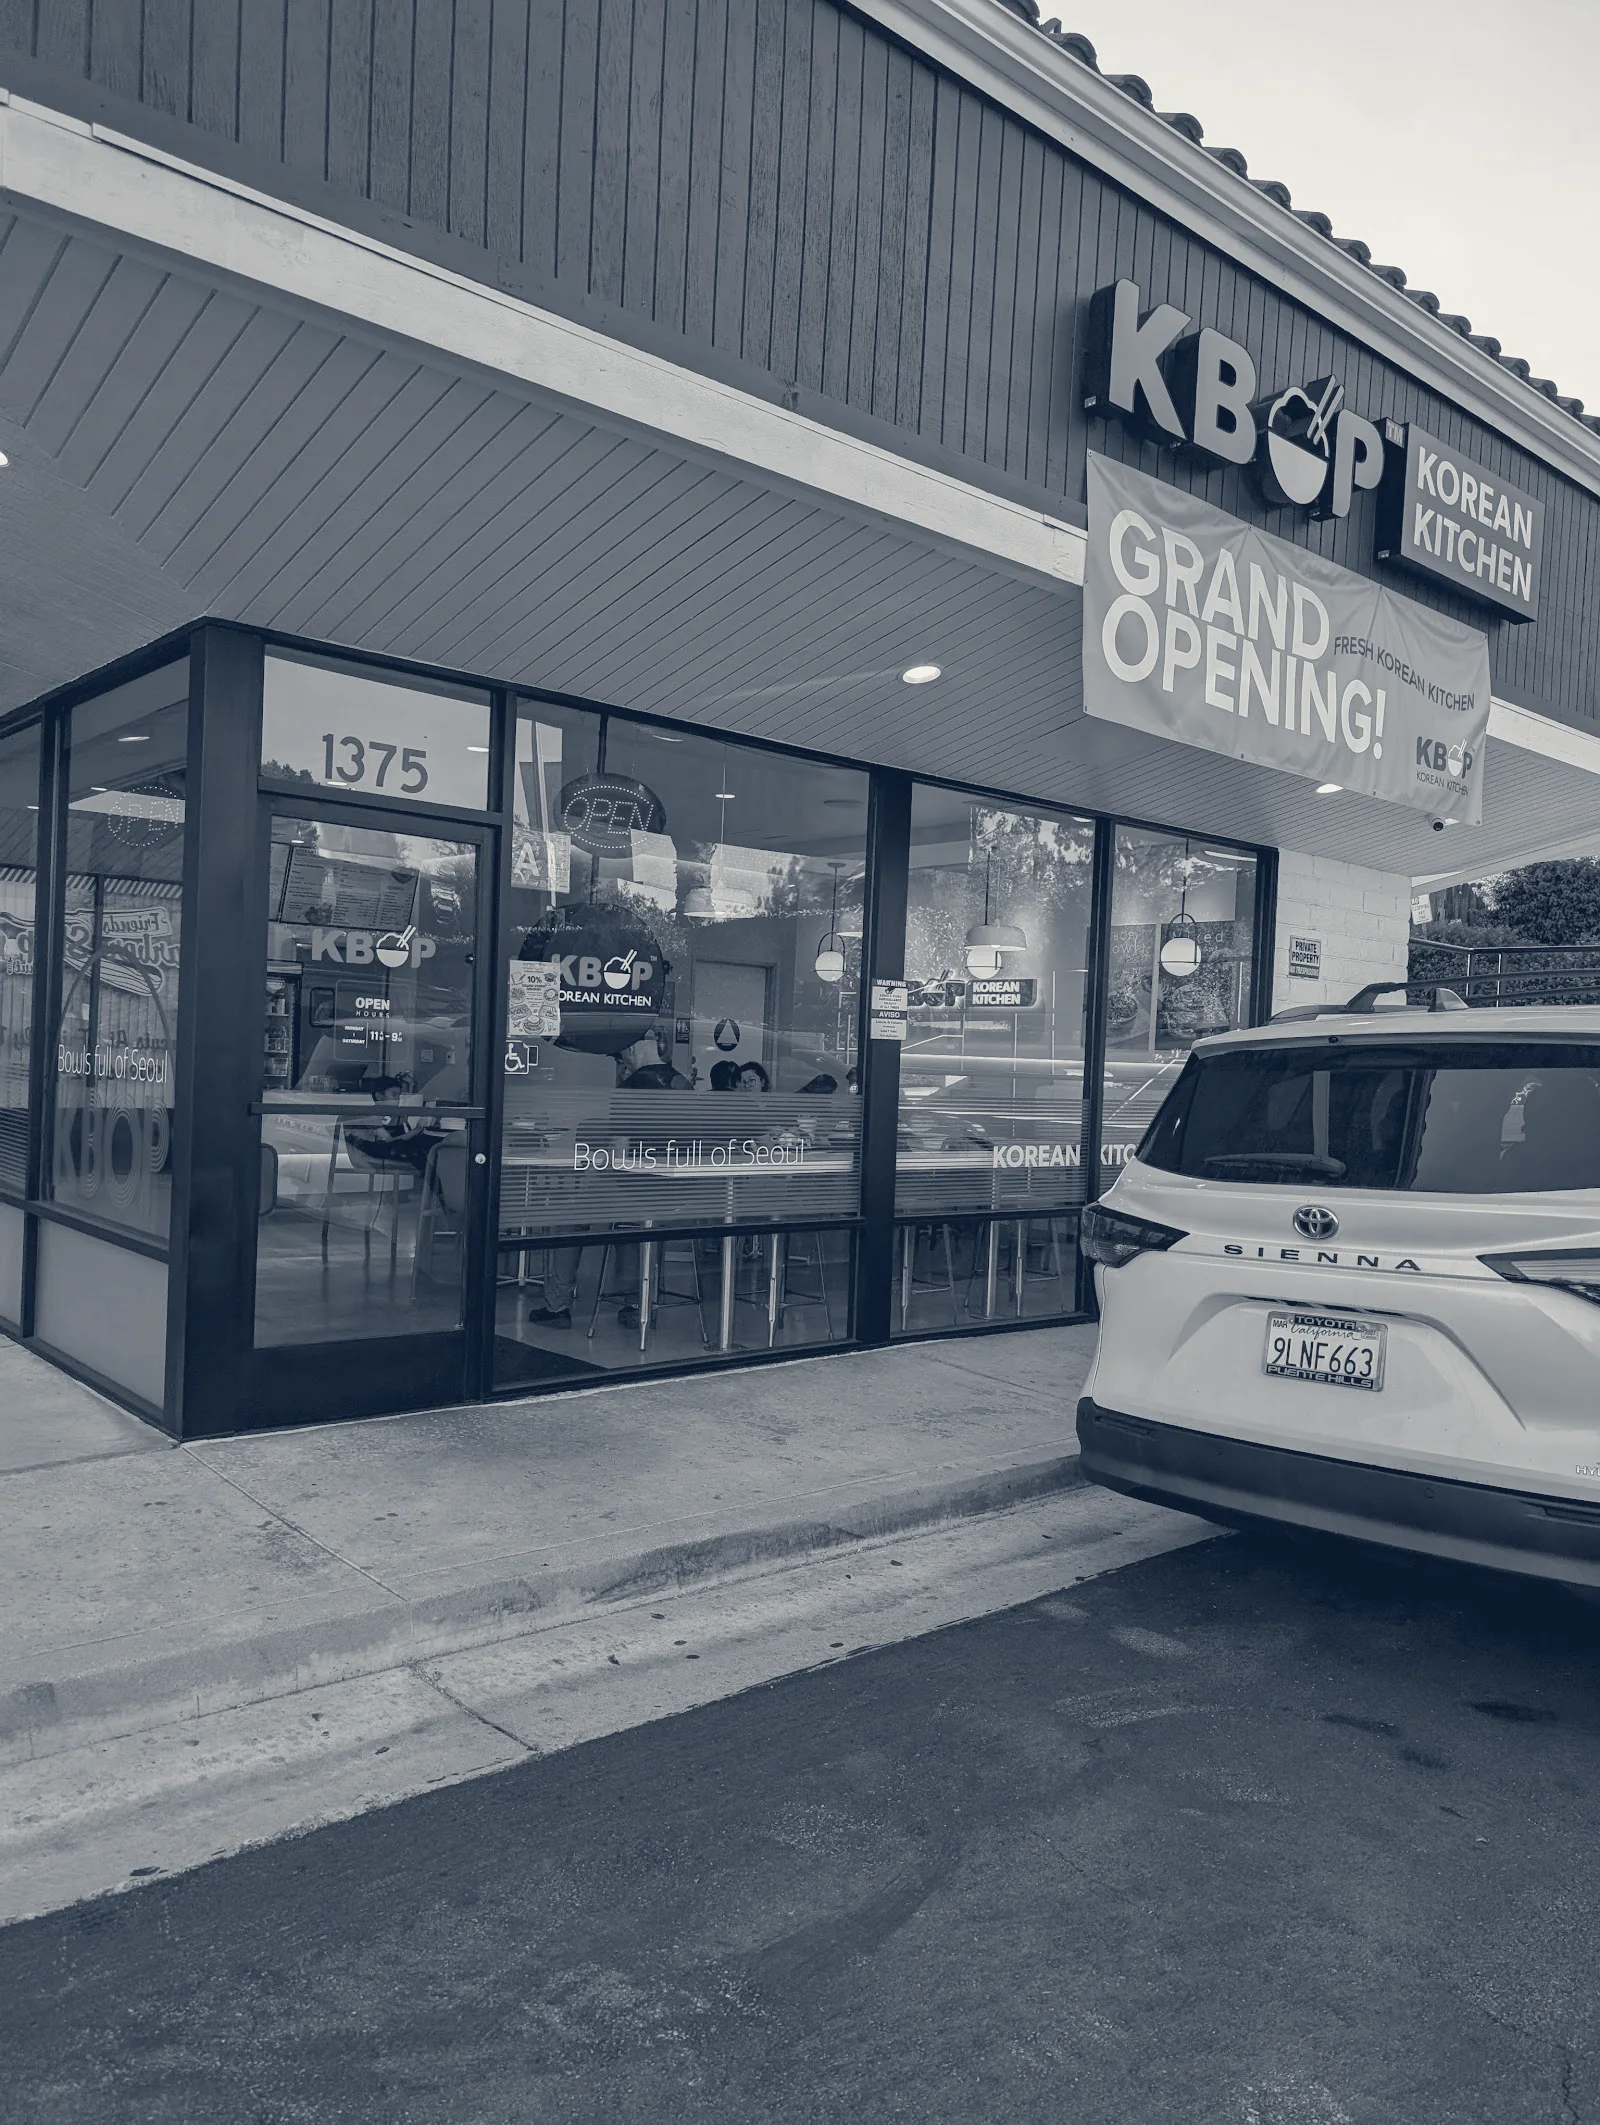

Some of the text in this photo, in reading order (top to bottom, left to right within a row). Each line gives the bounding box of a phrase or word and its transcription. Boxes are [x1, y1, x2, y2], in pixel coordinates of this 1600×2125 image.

[1417, 447, 1533, 550] KOREAN
[1414, 503, 1532, 602] KITCHEN
[1109, 509, 1330, 660] GRAND
[1102, 594, 1386, 760] OPENING!
[1334, 636, 1475, 711] FRESH KOREAN KITCHEN
[322, 733, 429, 793] 1375
[1416, 770, 1469, 796] KOREAN KITCHEN
[107, 801, 180, 833] OPEN
[564, 797, 654, 836] OPEN
[1292, 951, 1320, 964] PROPERTY
[1295, 941, 1317, 953] PRIVATE
[527, 975, 543, 983] 10%
[876, 979, 907, 987] WARNING
[972, 982, 1020, 993] KOREAN
[355, 997, 390, 1010] OPEN
[559, 990, 652, 1007] OREAN KITCHEN
[972, 993, 1021, 1005] KITCHEN
[355, 1010, 390, 1019] HOURS
[57, 1044, 168, 1083] Bowls full of Seoul
[573, 1139, 804, 1171] Bowls full of Seoul
[992, 1143, 1138, 1168] KOREAN KITC
[1223, 1244, 1421, 1271] SIENNA
[1272, 1319, 1288, 1329] MAR
[1290, 1322, 1361, 1340] California
[1294, 1315, 1356, 1330] TOYOTA
[1272, 1337, 1373, 1377] 9LNF663
[1268, 1365, 1372, 1388] PUENTE HILLS
